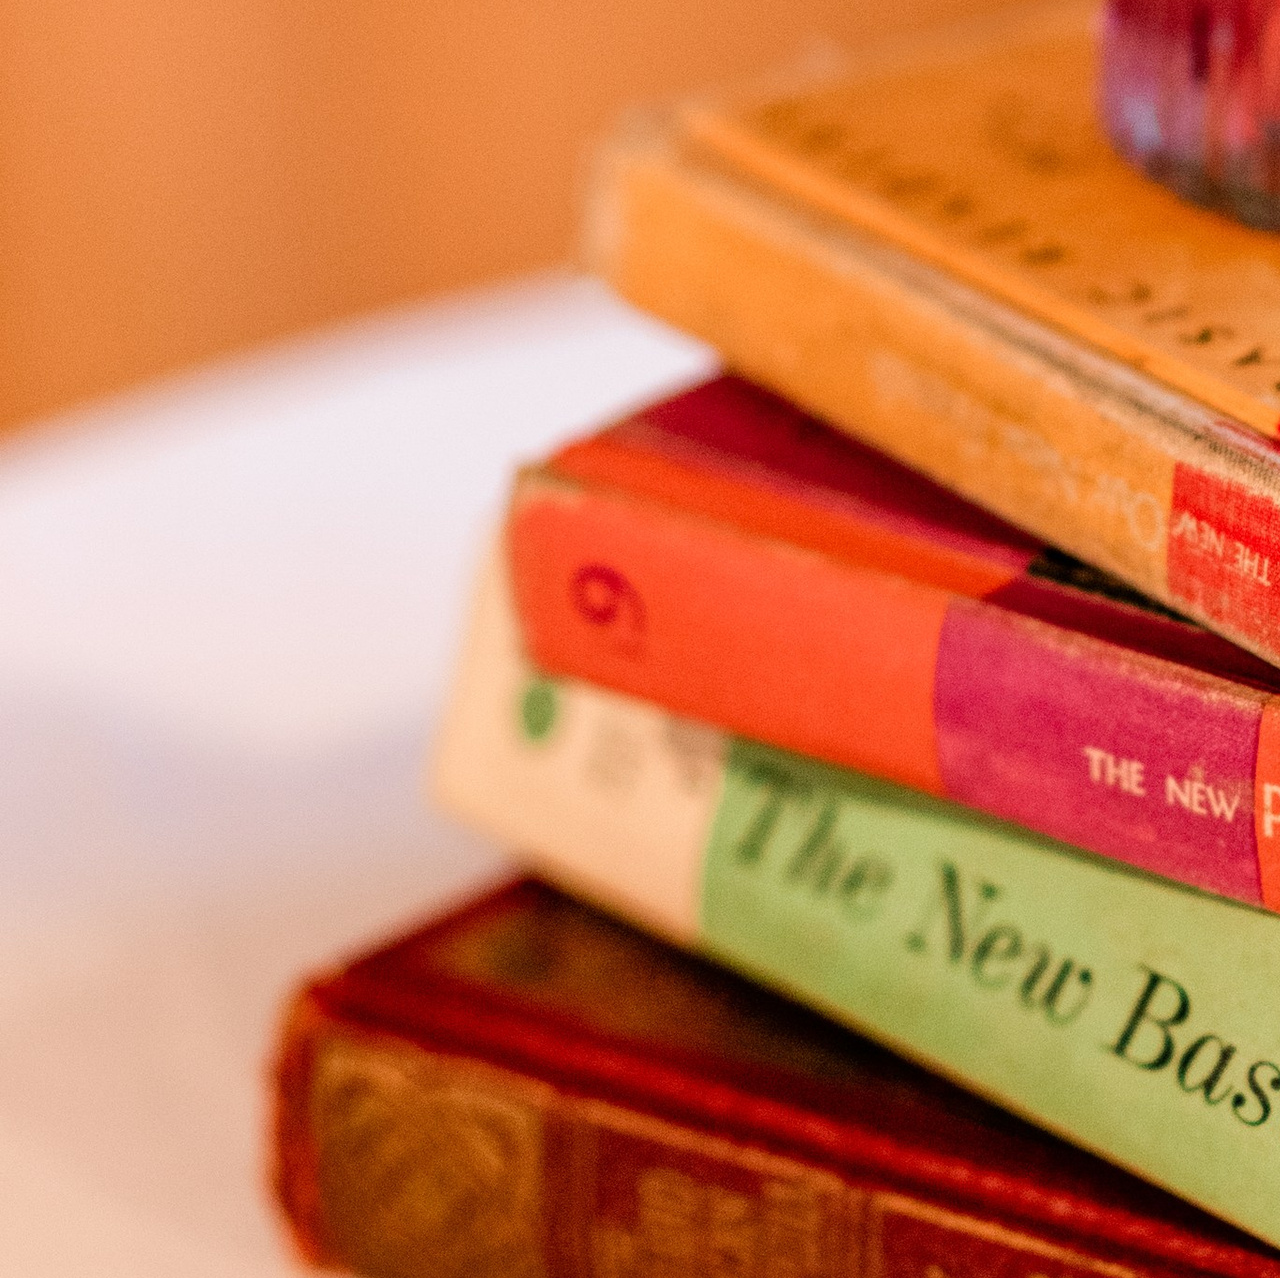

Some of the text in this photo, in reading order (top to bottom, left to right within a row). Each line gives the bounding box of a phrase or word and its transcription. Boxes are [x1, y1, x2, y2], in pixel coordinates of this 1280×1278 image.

[1222, 539, 1274, 588] THE
[1084, 745, 1146, 798] THE
[1164, 774, 1240, 822] NEW
[736, 758, 894, 923] The
[904, 858, 1094, 1028] New
